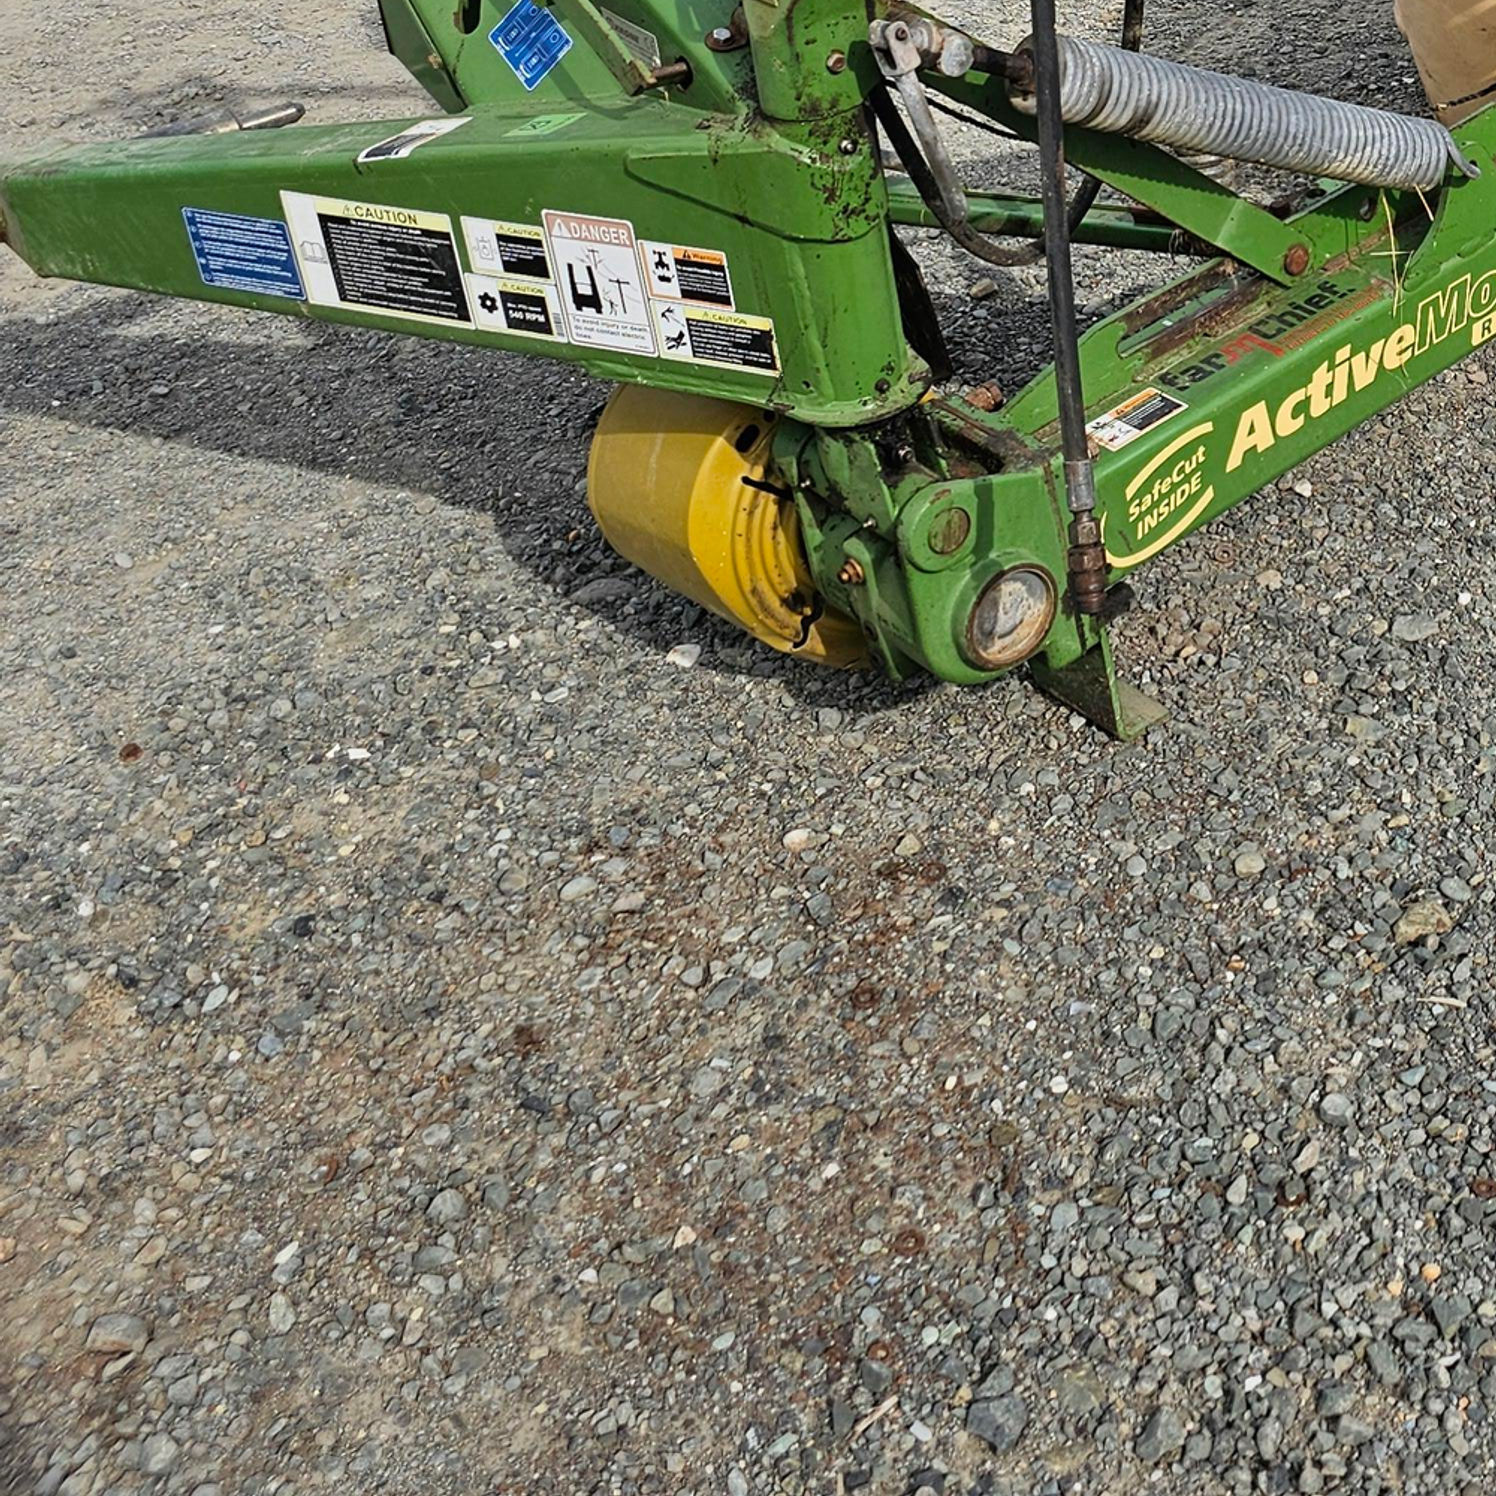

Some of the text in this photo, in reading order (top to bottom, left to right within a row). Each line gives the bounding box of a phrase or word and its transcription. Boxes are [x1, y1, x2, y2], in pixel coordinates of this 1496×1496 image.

[355, 206, 418, 226] CAUTION
[508, 226, 542, 238] CAUTION
[571, 222, 631, 246] DANGER
[511, 284, 544, 295] CAUTION
[509, 309, 546, 323] 540 RPM
[713, 315, 748, 326] CAUTION
[1480, 320, 1493, 336] R
[1129, 445, 1206, 522] SafeCut
[1136, 471, 1202, 541] INSIDE
